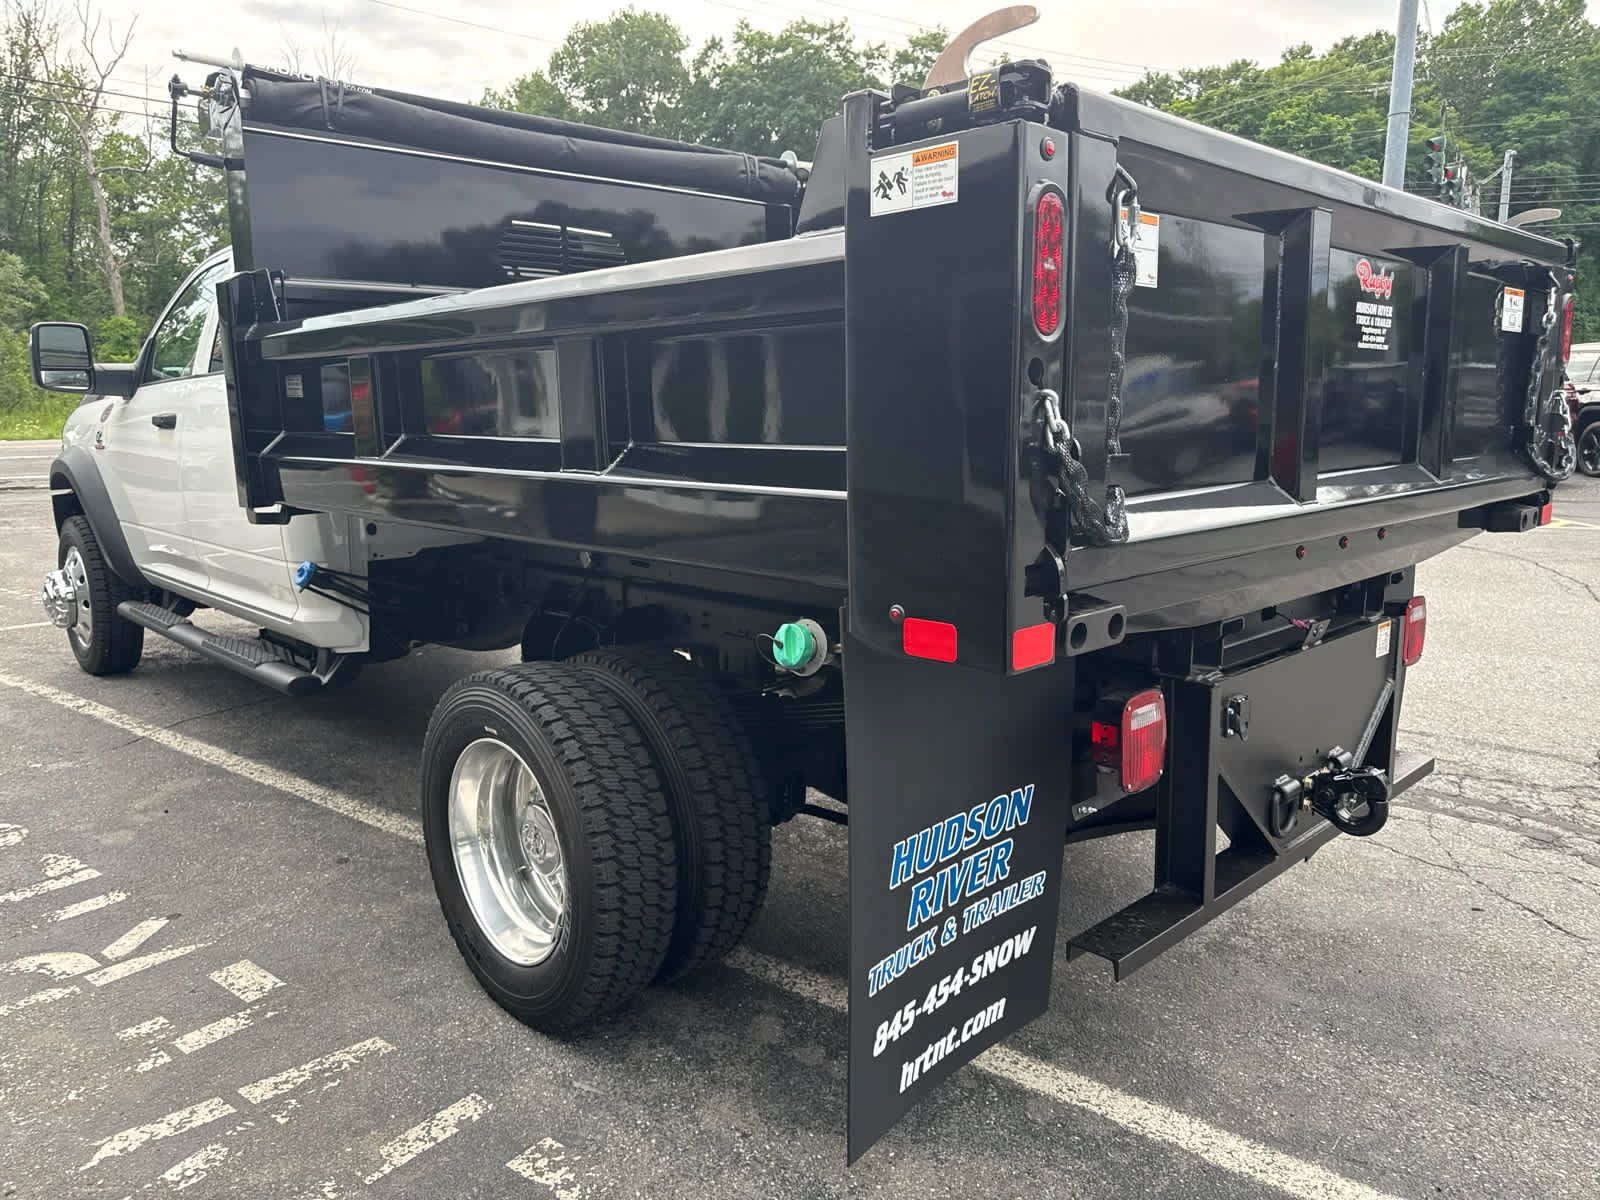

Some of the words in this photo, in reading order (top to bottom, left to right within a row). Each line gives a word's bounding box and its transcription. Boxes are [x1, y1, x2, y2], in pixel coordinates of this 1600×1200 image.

[920, 147, 955, 161] WARNING
[889, 783, 1035, 890] HUDSON
[907, 838, 1013, 931] RIVER
[868, 925, 938, 998] TRUCK
[941, 916, 957, 942] &
[963, 870, 1047, 935] TRAILER
[873, 925, 1037, 1057] 845-454-SNOW
[899, 997, 1007, 1094] hrtnt.com
